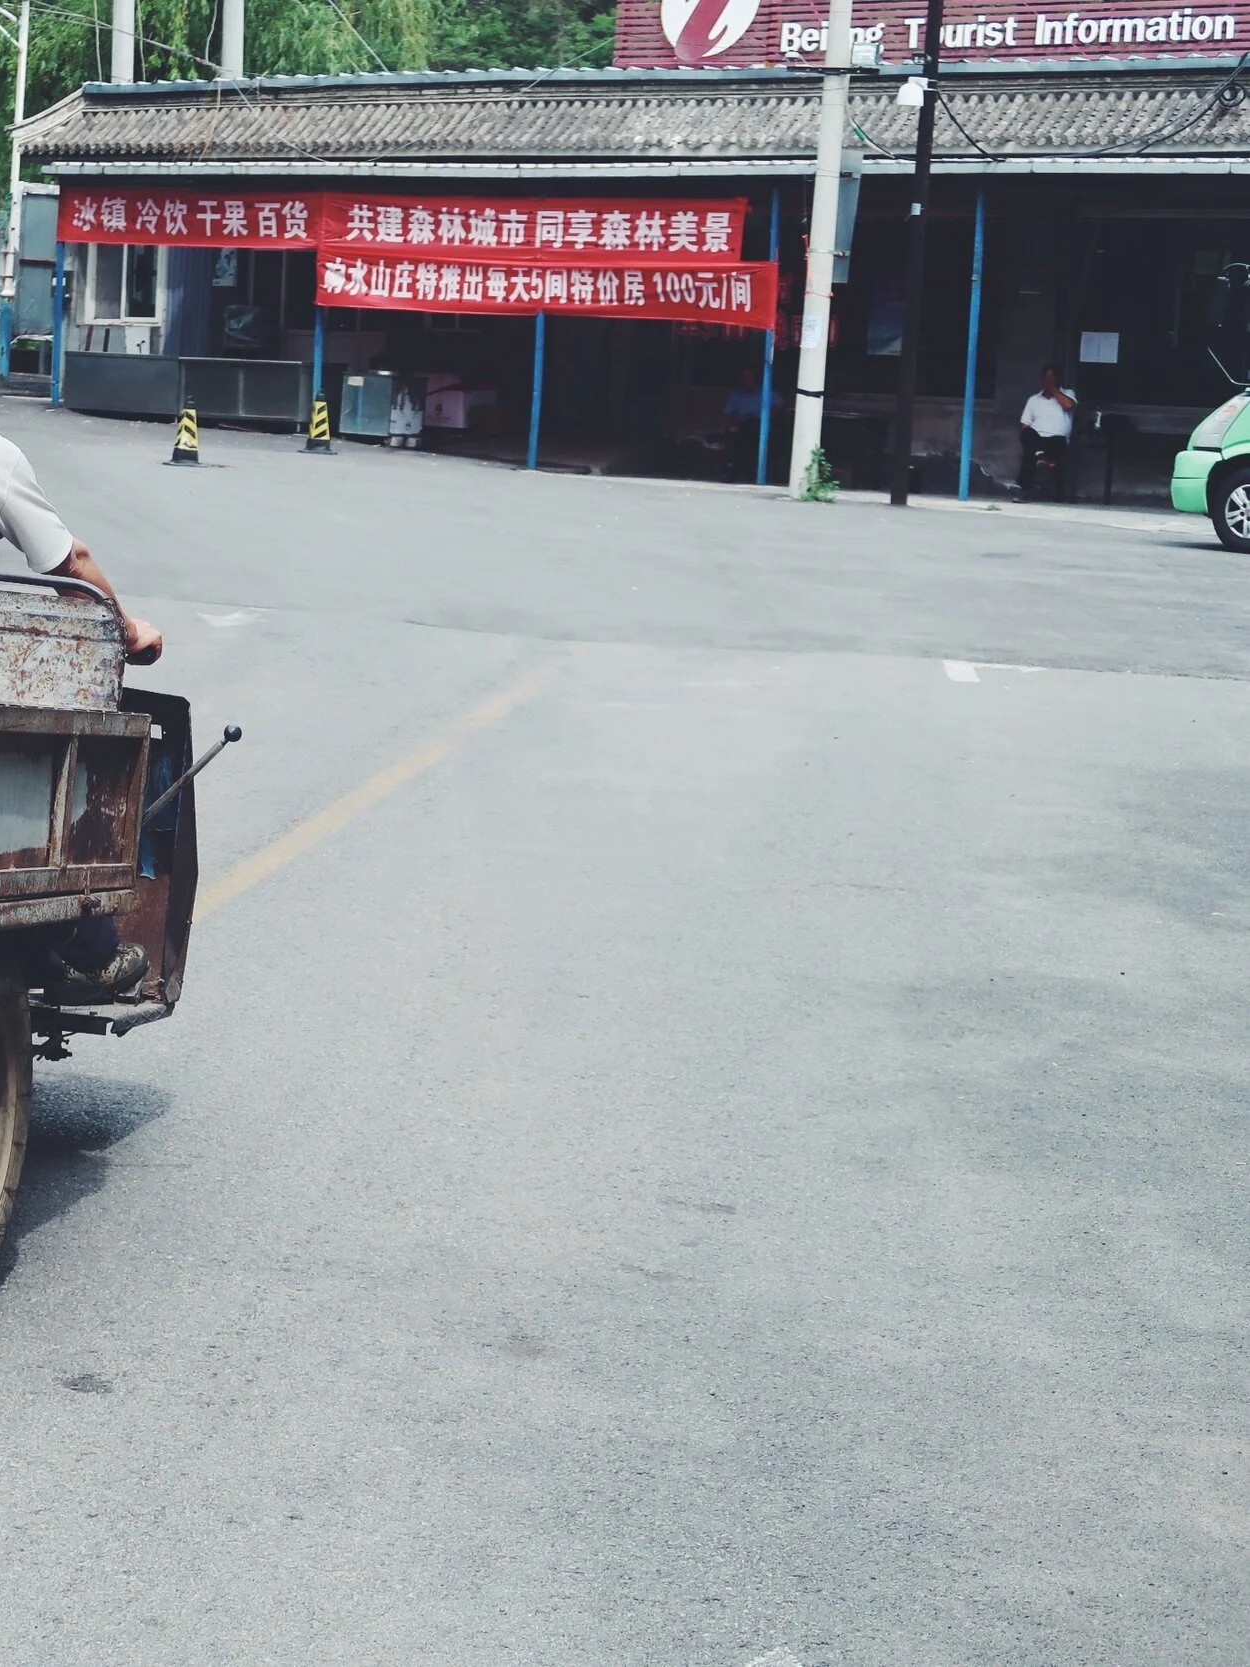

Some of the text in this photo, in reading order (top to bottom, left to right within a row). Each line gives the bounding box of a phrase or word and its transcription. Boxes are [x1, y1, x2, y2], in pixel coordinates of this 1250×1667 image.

[780, 8, 1236, 55] Being Turist Information
[73, 196, 309, 240] 冰镇 冷饮 干果 百货
[652, 271, 751, 312] 100元/间
